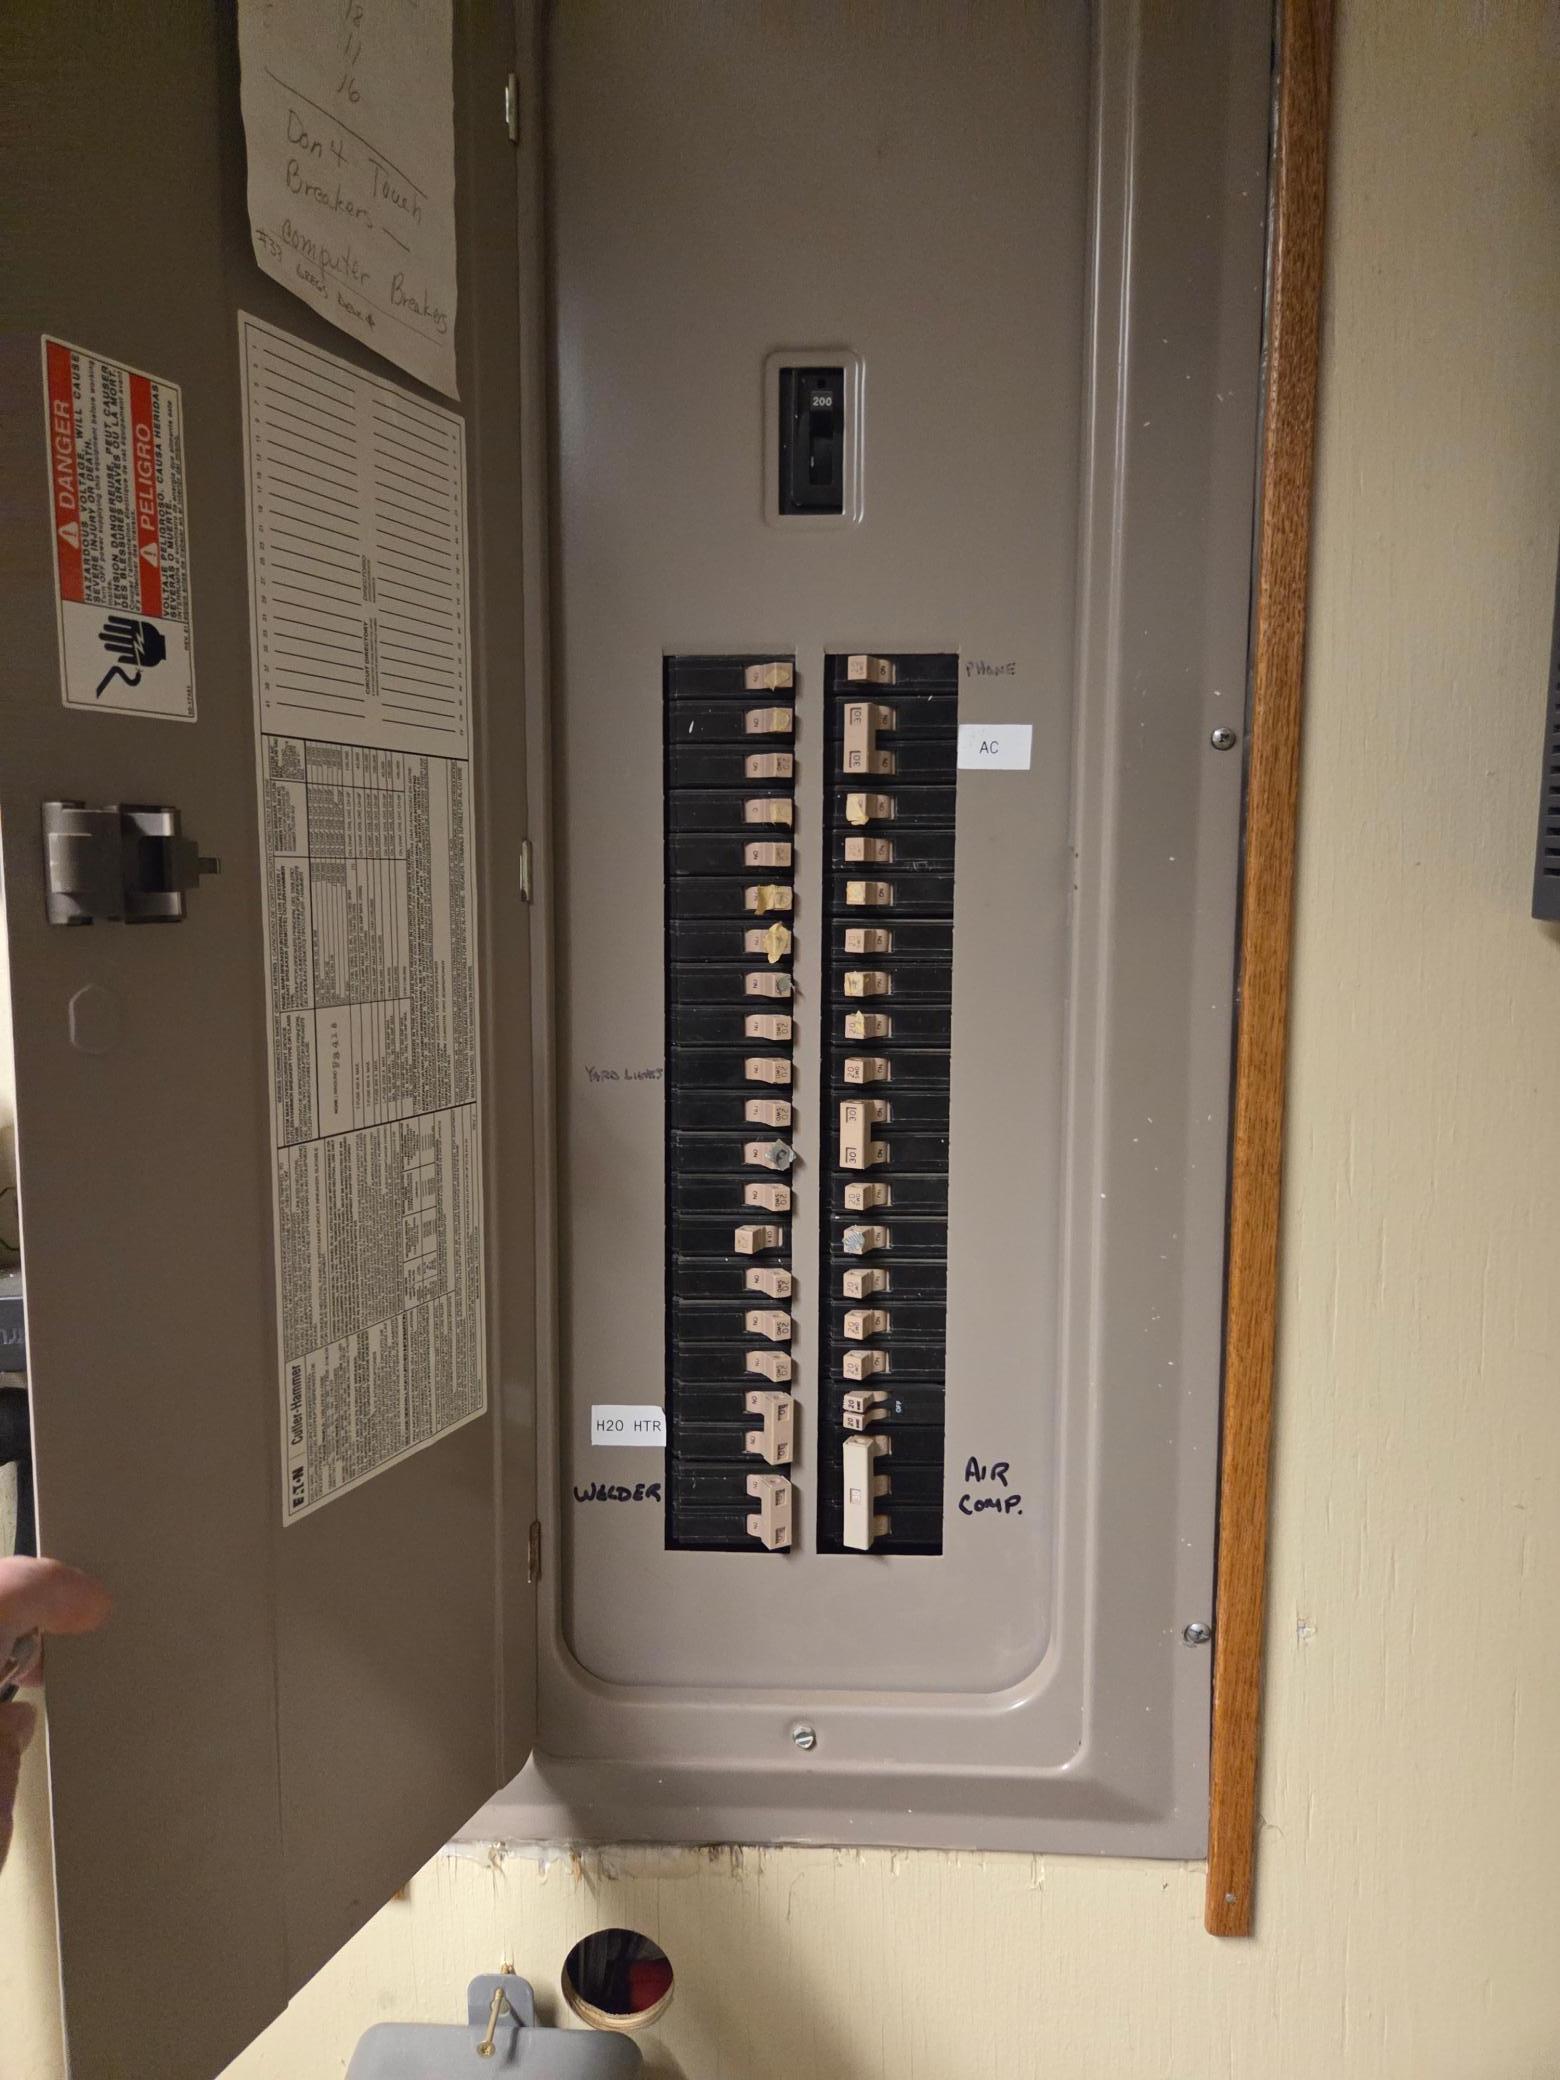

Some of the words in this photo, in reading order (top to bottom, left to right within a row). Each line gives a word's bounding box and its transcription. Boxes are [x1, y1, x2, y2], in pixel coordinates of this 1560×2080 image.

[369, 158, 423, 224] Touch
[71, 355, 81, 400] CAUSE
[101, 365, 110, 416] CAUSER
[108, 368, 117, 405] MORT.
[75, 408, 83, 439] WILL
[110, 411, 118, 427] LA
[151, 385, 161, 438] HERIDAS
[813, 397, 832, 406] 200
[54, 399, 75, 509] DANGER
[85, 438, 93, 481] DEATH.
[104, 423, 112, 455] PEUT
[112, 432, 119, 449] OU
[113, 455, 122, 503] GRAVES
[136, 423, 155, 531] PELIGRO
[155, 440, 163, 484] CAUSA
[87, 482, 95, 504] OR
[88, 508, 98, 551] INJURY
[116, 506, 126, 580] BLESSURES
[164, 499, 174, 550] MUERTE.
[81, 521, 92, 602] HAZARDOUS
[91, 556, 101, 603] SEVERE
[111, 554, 120, 607] TENSION
[120, 585, 128, 609] DES
[160, 566, 170, 617] VOLTAJE
[168, 566, 177, 618] SEVERAS
[979, 741, 999, 754] AC
[290, 1366, 303, 1445] Cutler-Hammer
[633, 1420, 662, 1431] HTR
[573, 1482, 661, 1502] WELDER
[965, 1456, 1009, 1487] AIR
